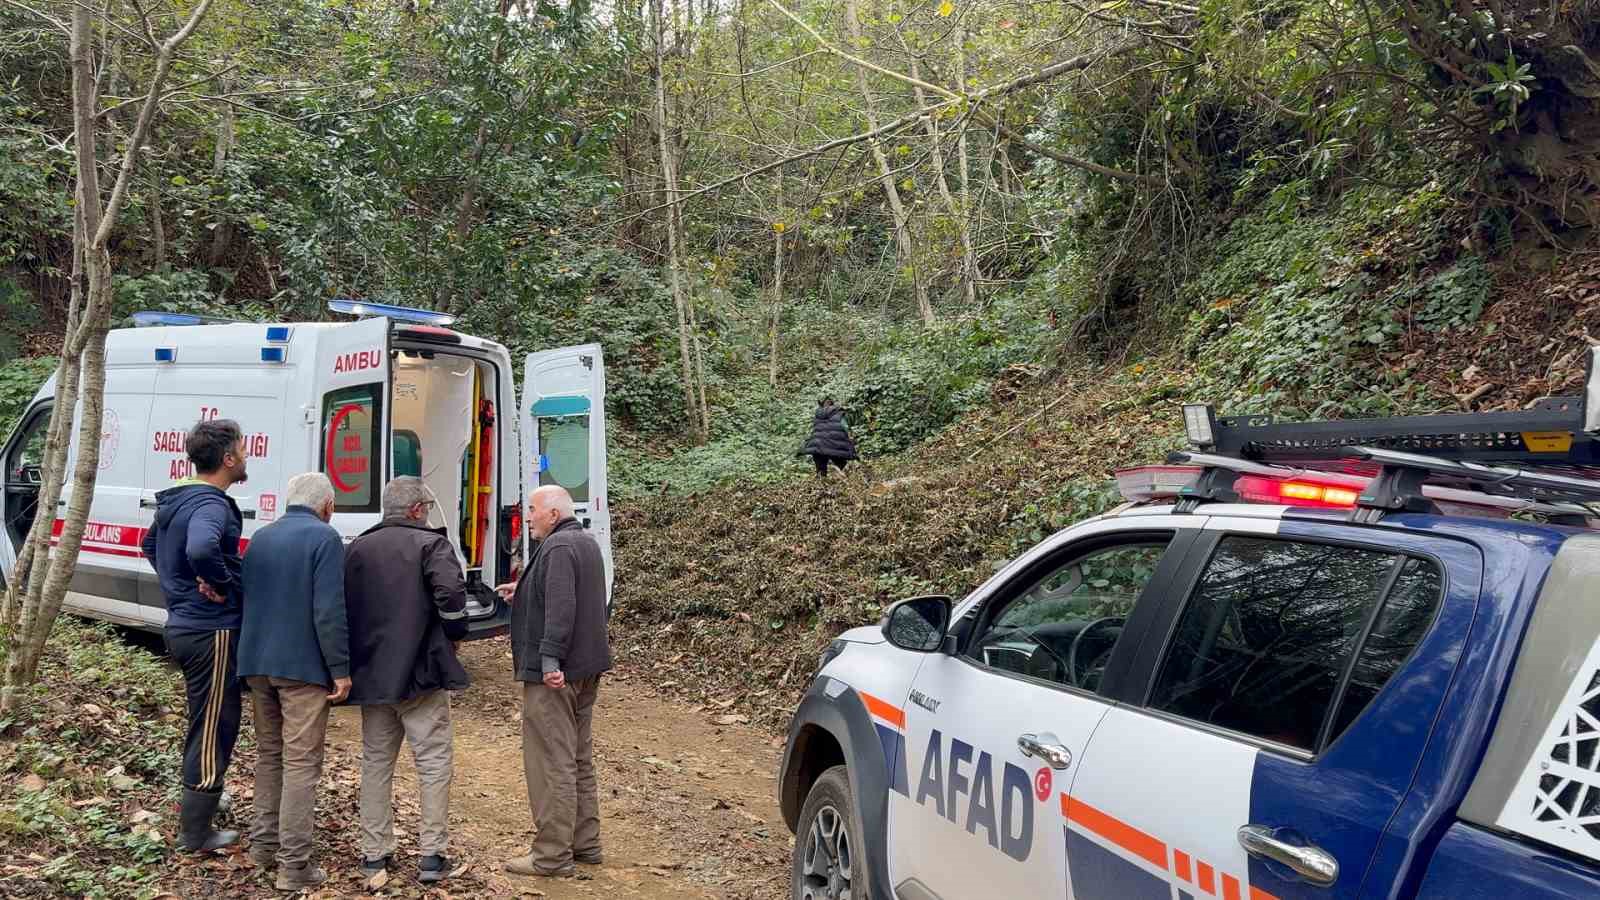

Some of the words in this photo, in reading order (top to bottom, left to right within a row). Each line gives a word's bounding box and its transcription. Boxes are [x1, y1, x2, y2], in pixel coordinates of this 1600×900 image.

[334, 350, 381, 374] AMBU
[153, 428, 189, 453] SAĞLI
[82, 524, 121, 544] BULANS
[915, 728, 1035, 863] AFAD
